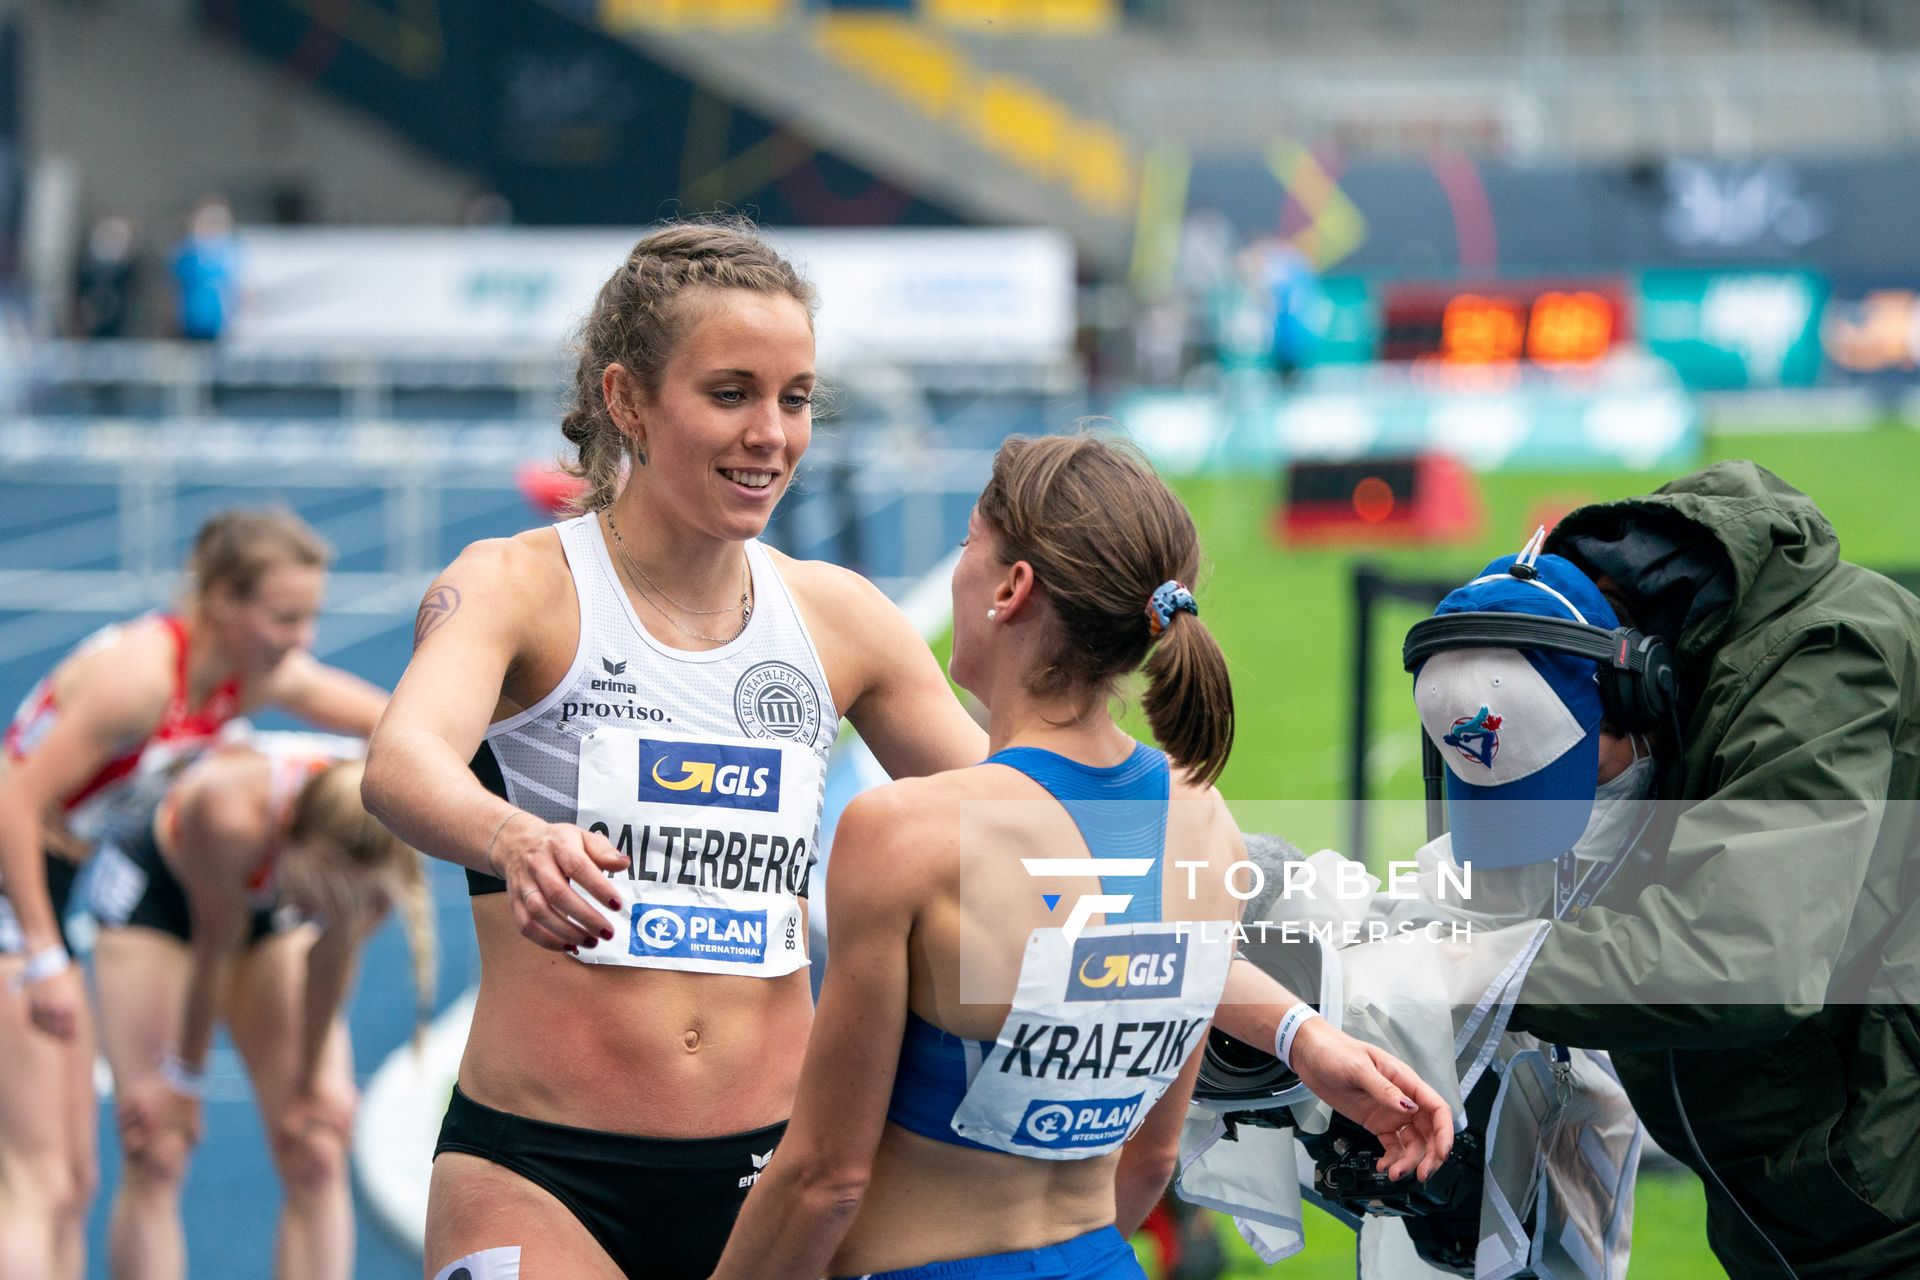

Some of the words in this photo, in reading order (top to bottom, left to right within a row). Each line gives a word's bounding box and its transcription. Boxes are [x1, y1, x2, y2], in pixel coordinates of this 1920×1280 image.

[591, 678, 637, 695] erima
[560, 699, 672, 723] proviso.
[714, 764, 770, 797] GLS
[588, 821, 806, 896] ALTERBERG
[690, 916, 763, 945] PLAN
[784, 916, 797, 951] 298
[690, 942, 761, 957] INTERNATIONAL
[1127, 952, 1177, 986] GLS
[999, 1017, 1204, 1081] KRAFZIK
[1074, 1103, 1138, 1130] PLAN
[738, 1171, 762, 1188] eri
